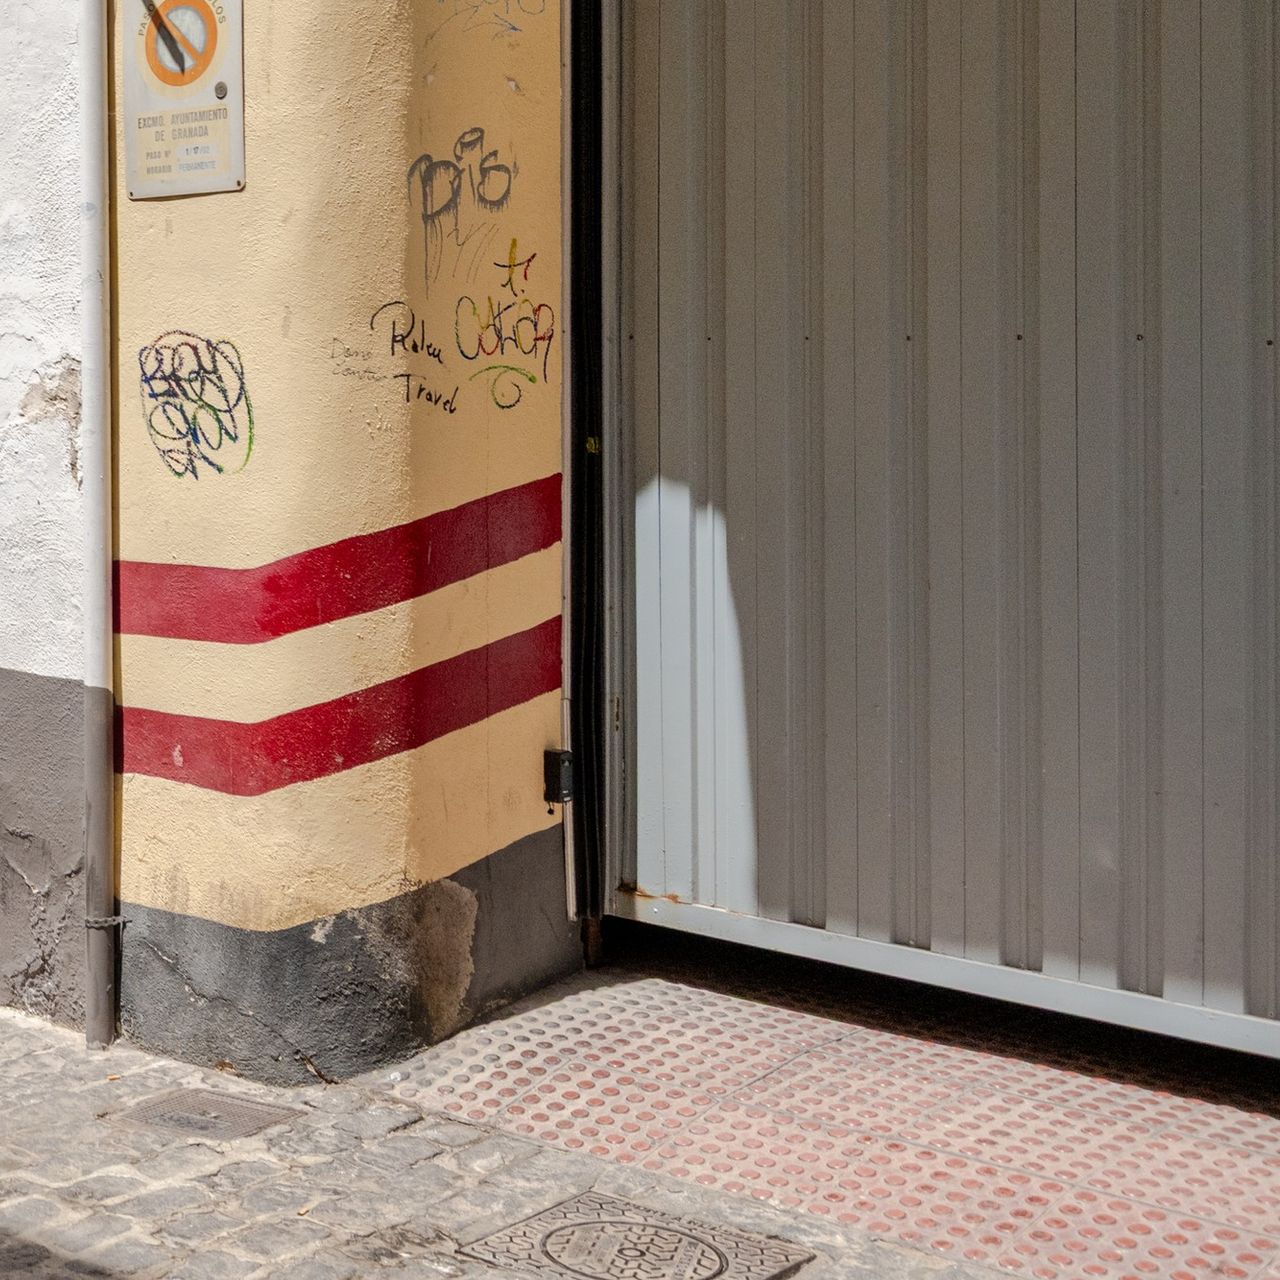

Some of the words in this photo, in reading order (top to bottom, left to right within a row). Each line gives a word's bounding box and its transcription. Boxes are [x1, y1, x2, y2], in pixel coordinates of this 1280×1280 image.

[138, 3, 156, 36] PASO
[171, 107, 228, 124] AYUNTAMIENTO
[155, 130, 165, 141] DE
[171, 125, 209, 140] GRANADA
